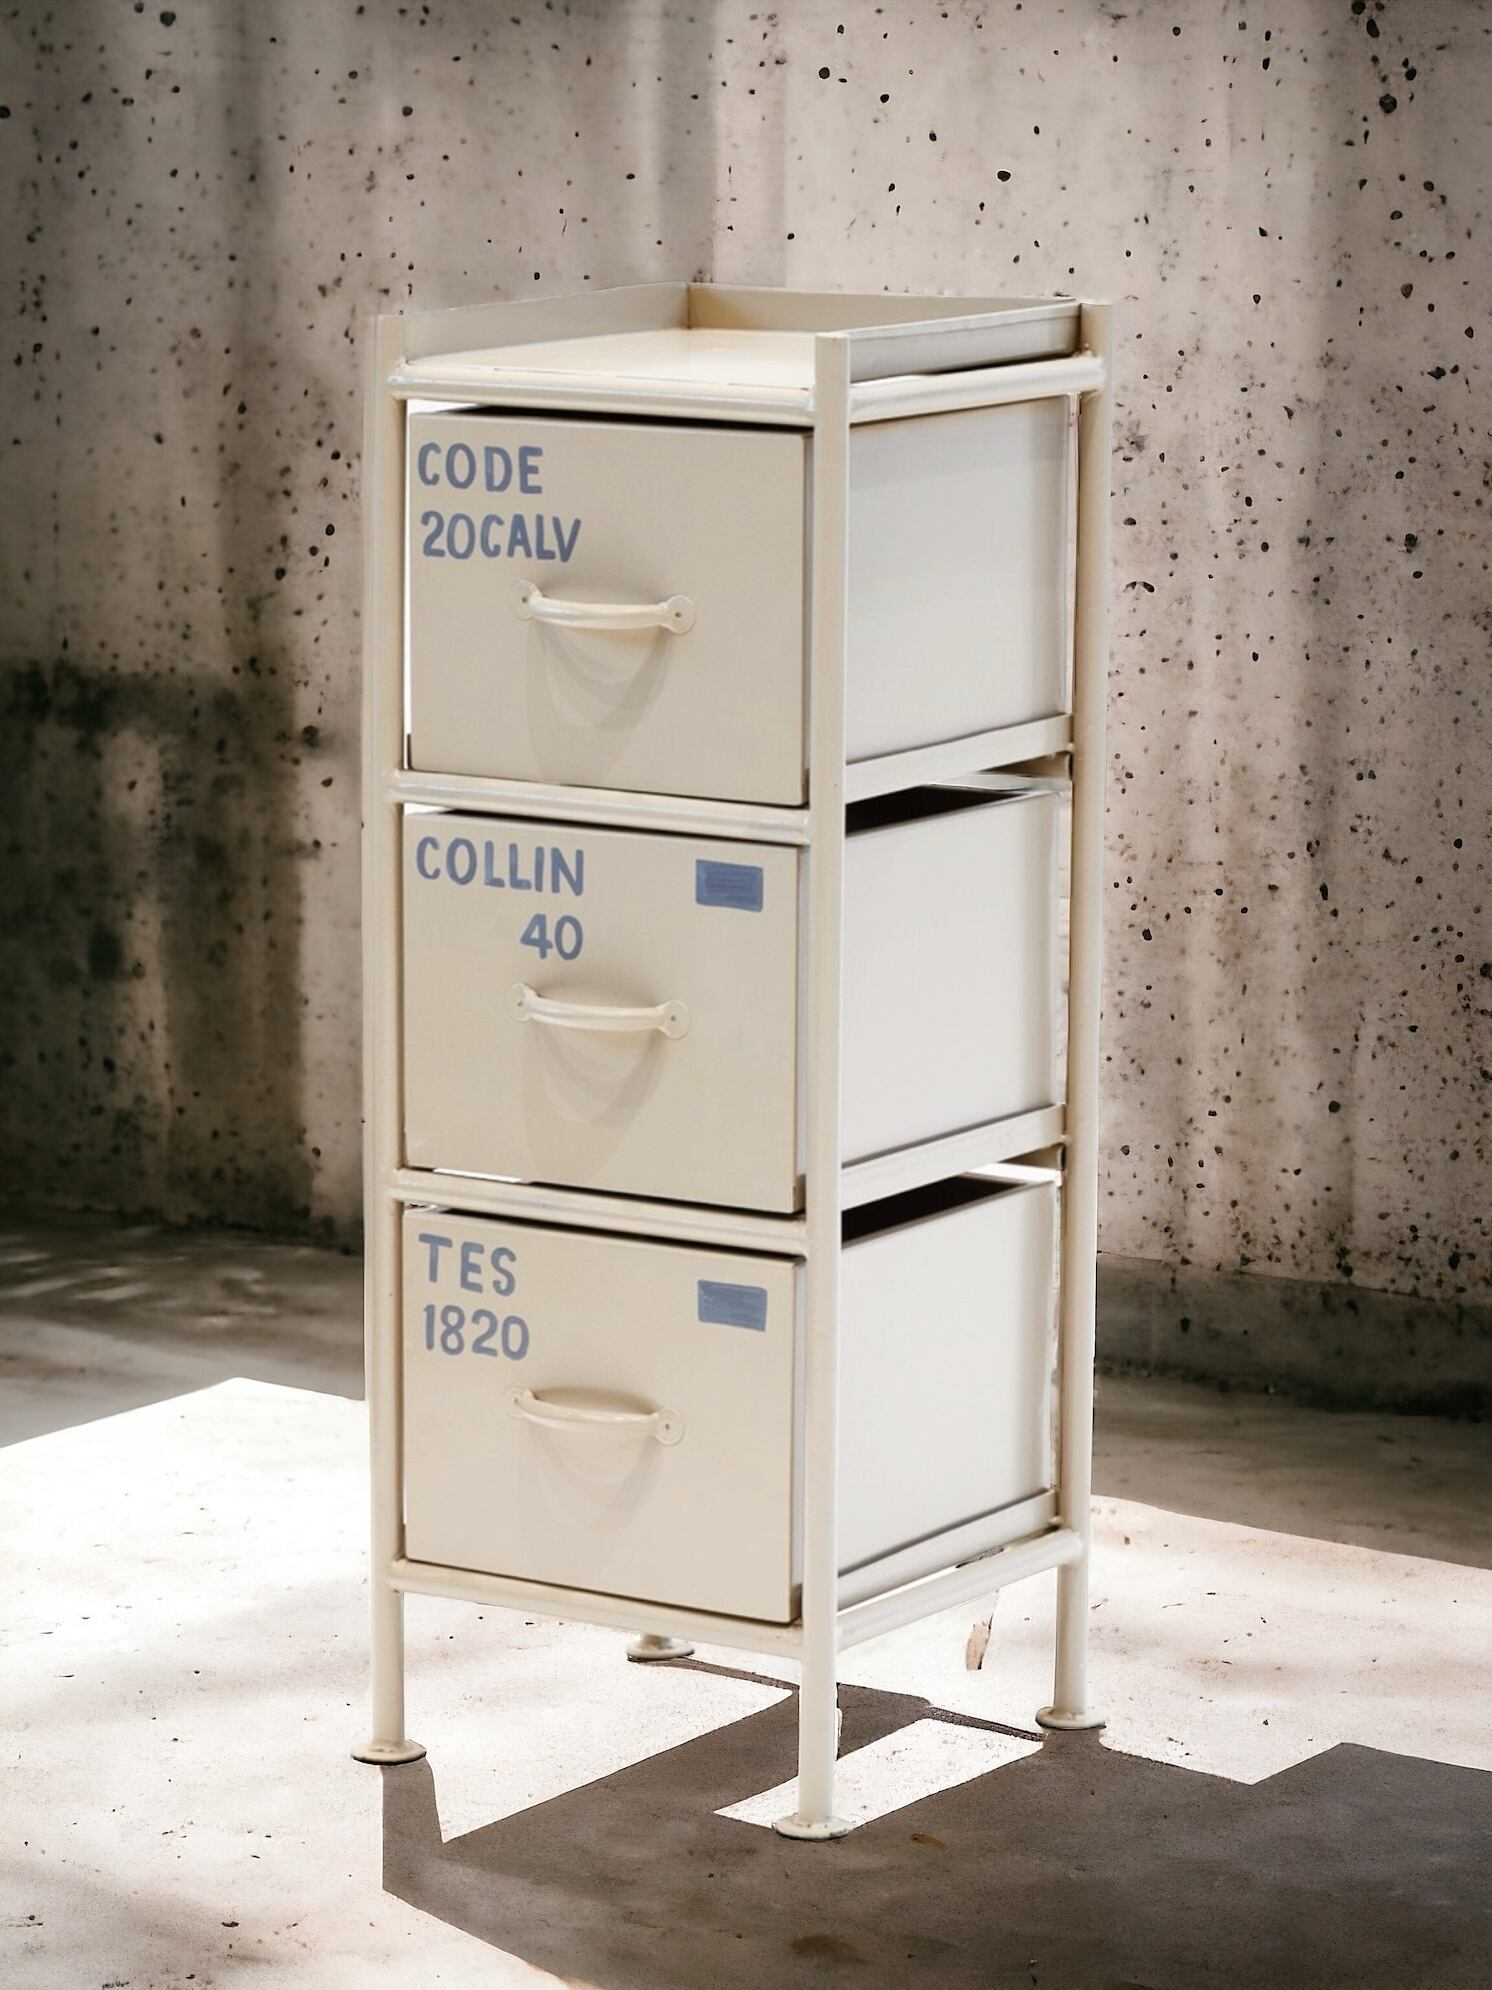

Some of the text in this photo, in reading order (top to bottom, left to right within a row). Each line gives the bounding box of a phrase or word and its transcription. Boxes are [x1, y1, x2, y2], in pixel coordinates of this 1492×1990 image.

[417, 442, 543, 494] CODE
[420, 510, 581, 562] 20CALV
[416, 836, 584, 896] COLLIN
[520, 913, 584, 960] 40
[418, 1233, 518, 1297] TES
[423, 1304, 530, 1361] 1820
